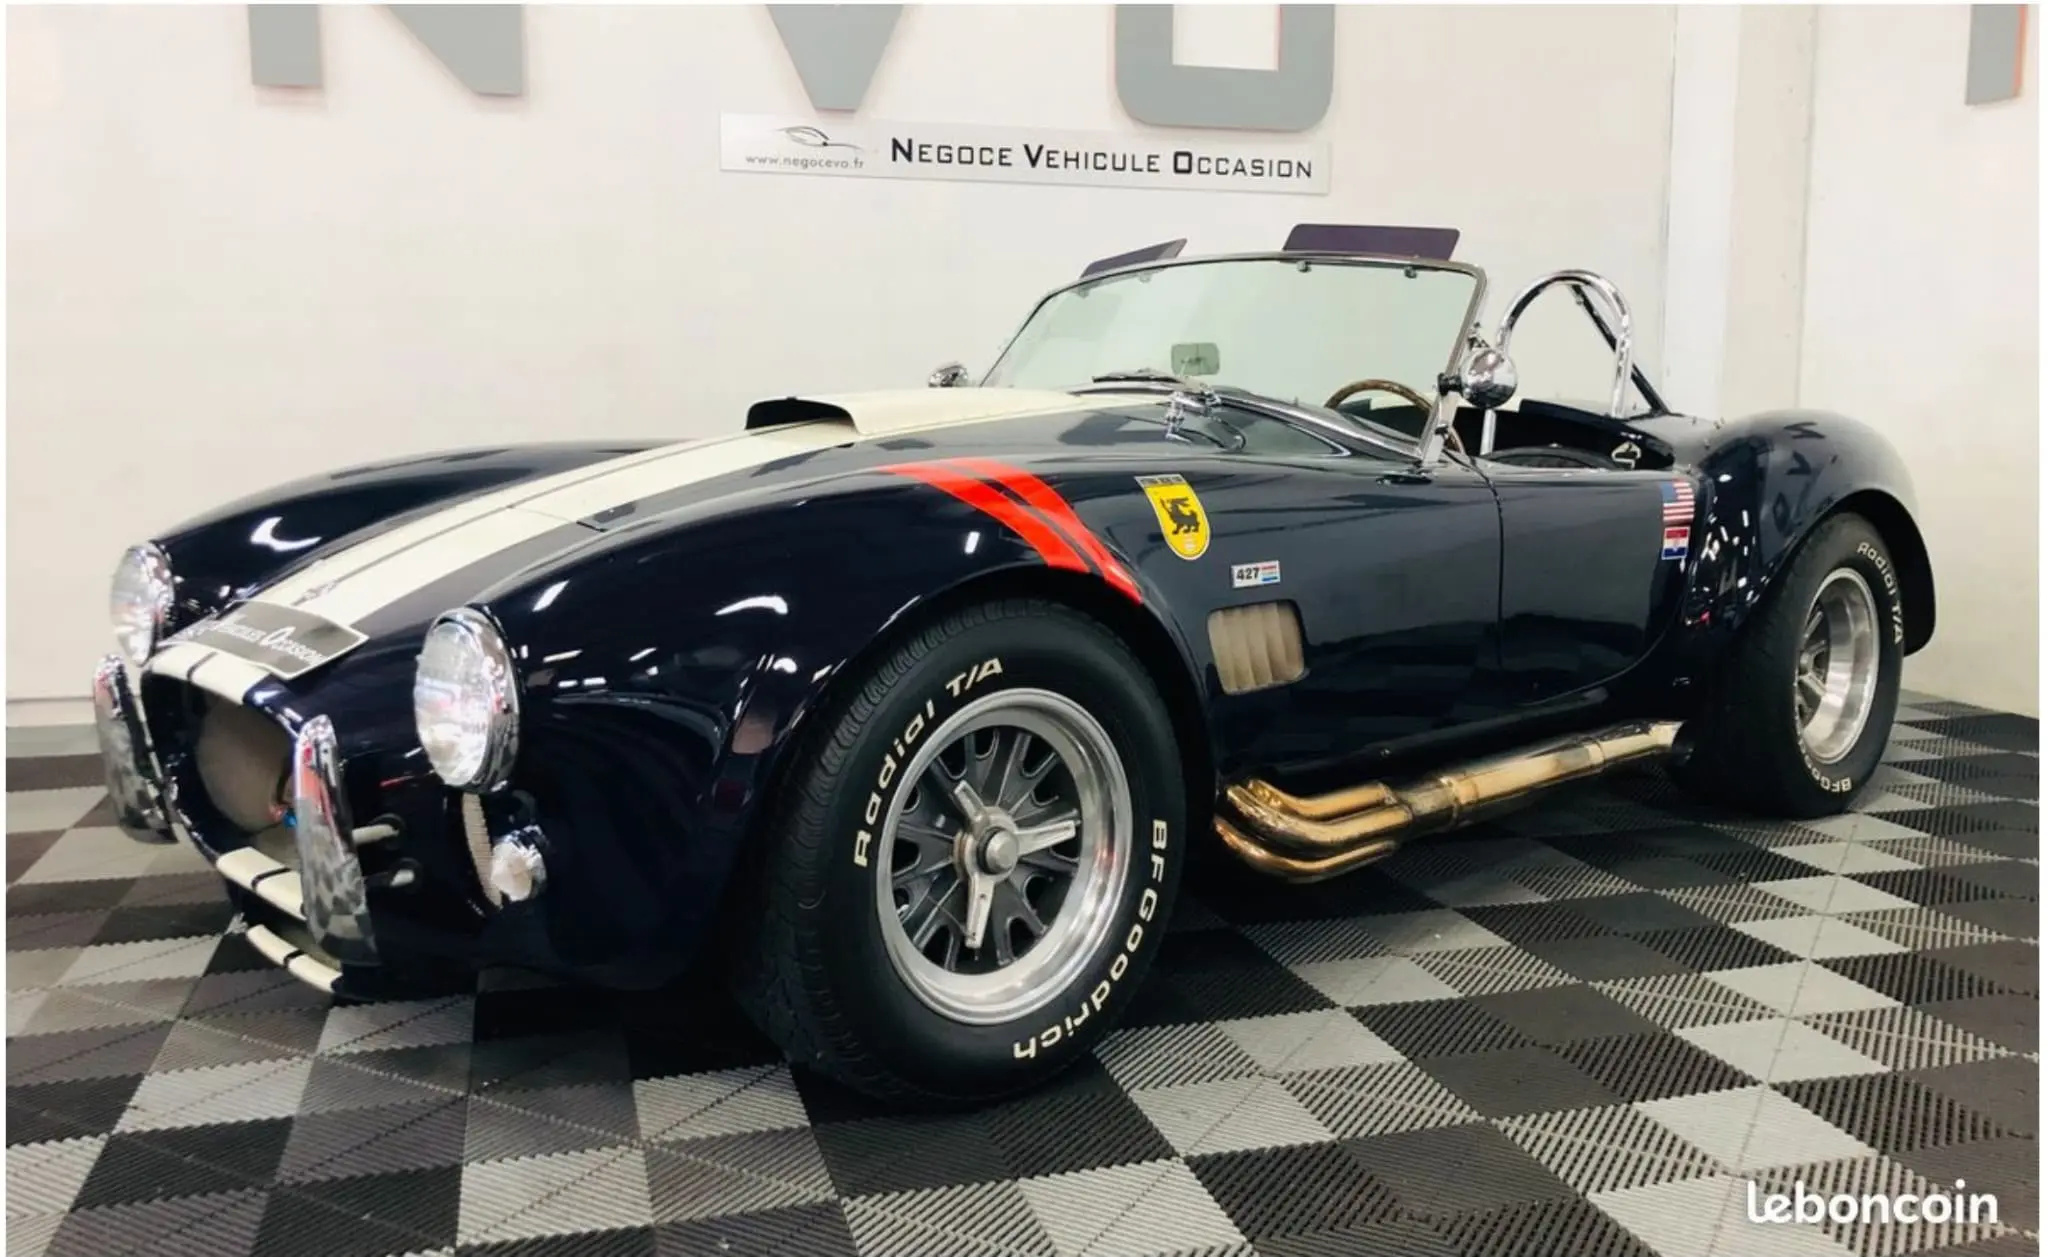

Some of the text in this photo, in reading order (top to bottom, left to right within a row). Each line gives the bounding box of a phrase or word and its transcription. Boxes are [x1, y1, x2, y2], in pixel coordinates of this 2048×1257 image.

[745, 155, 864, 170] www.negocevo.fr
[891, 137, 1312, 179] NEGOCE VEHICULE OCCASION
[1236, 566, 1260, 580] 427
[1857, 541, 1897, 595] Radial
[853, 657, 1004, 868] Radial T/A
[1012, 819, 1169, 1062] BFGoodrich
